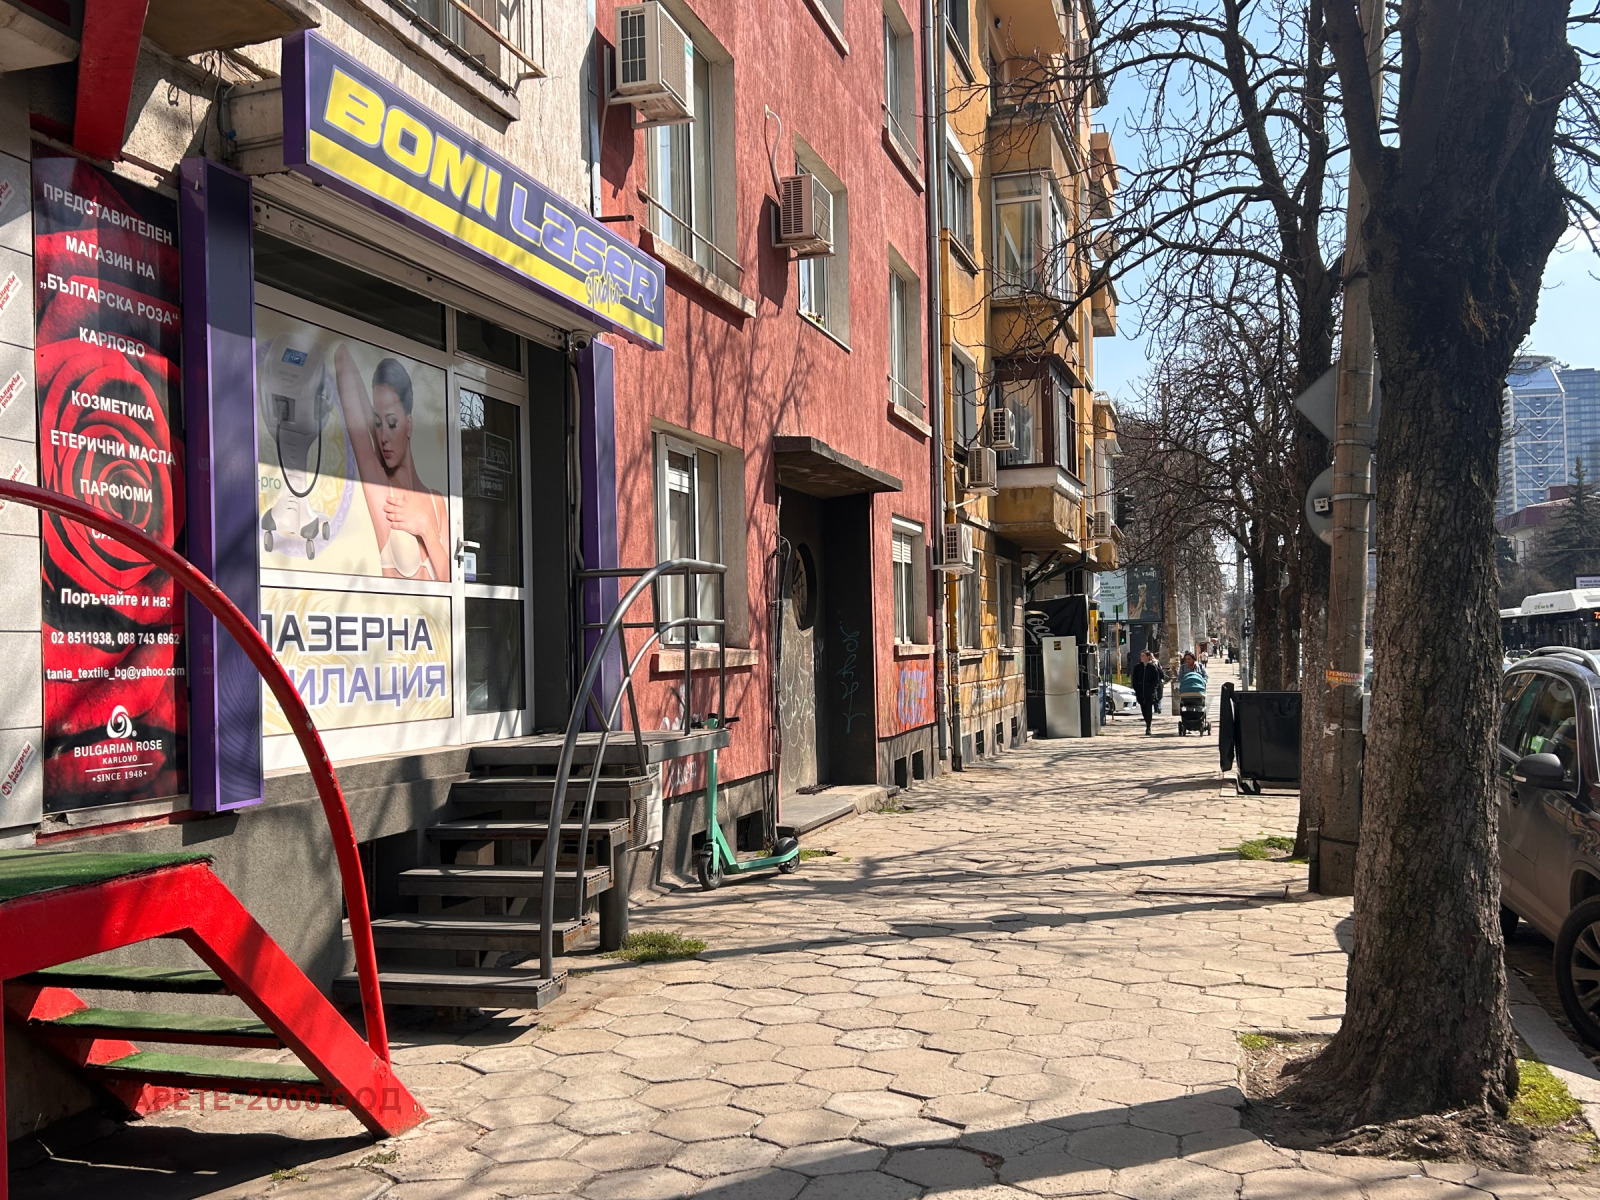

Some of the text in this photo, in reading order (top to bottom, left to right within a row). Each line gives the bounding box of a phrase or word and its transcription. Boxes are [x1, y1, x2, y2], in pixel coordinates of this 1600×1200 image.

[324, 64, 502, 222] BOMI
[43, 183, 172, 245] ПРЕДСТАВИТЕЛЕН
[66, 235, 155, 280] МАГАЗИН НА
[79, 326, 145, 358] КАРЛОВО
[71, 390, 154, 422] КОЗМЕТИКА
[50, 429, 177, 466] ЕТЕРИЧНИ МАСЛА
[80, 478, 153, 503] ПАРФЮМИ
[61, 588, 171, 608] Поръчайте и на:
[51, 631, 180, 646] 02 8511938, 088 743 6962
[46, 665, 185, 681] tania_textile_bg@yahoo.com
[289, 664, 446, 707] ИЛАЦИЯ
[74, 740, 162, 758] BULGARIAN ROSE
[102, 755, 138, 765] KARLOVO
